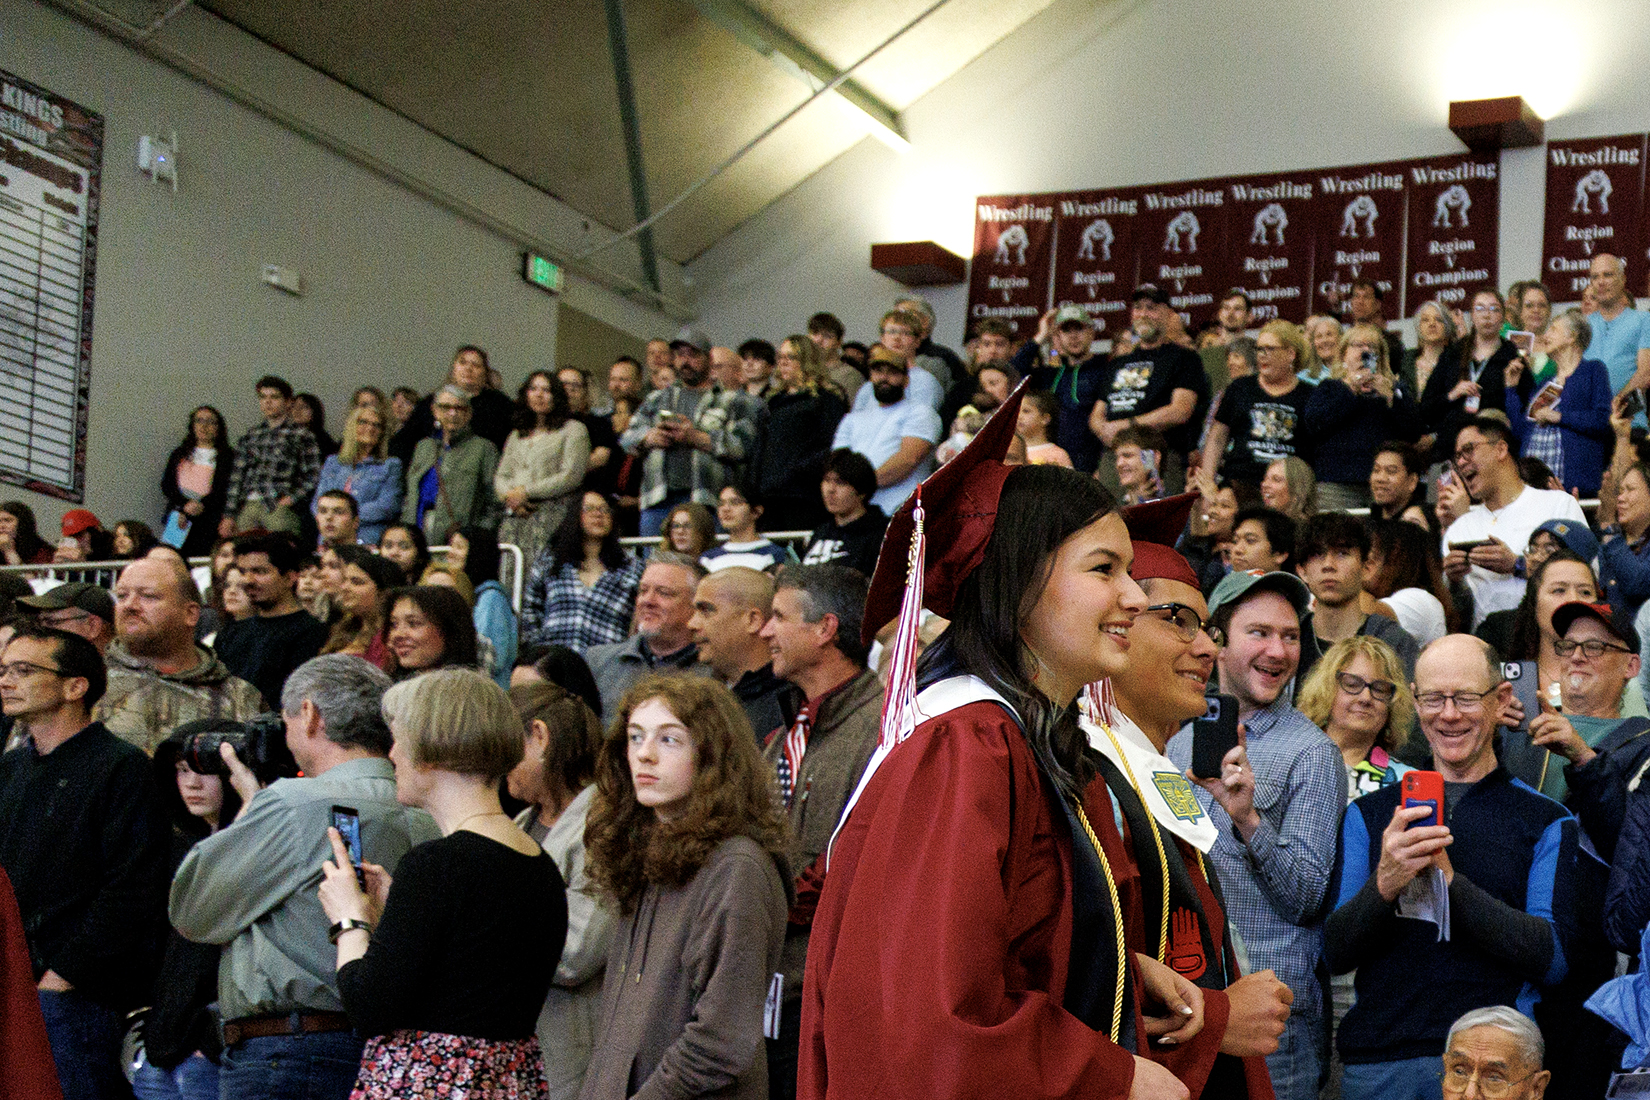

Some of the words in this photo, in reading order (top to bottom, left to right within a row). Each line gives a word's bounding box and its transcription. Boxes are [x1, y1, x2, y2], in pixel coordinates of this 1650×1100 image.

[1551, 146, 1640, 166] Wrestling
[1411, 162, 1498, 185] Wrestling
[1231, 181, 1313, 201] Wrestling
[1321, 172, 1404, 194] Wrestling
[1060, 197, 1138, 217] Wrestling
[1144, 189, 1224, 210] Wrestling
[977, 203, 1054, 223] Wrestling
[1566, 225, 1614, 242] Region
[1428, 238, 1476, 255] Region
[1584, 241, 1595, 255] V
[1244, 256, 1289, 272] Region
[1335, 249, 1380, 266] Region
[1446, 254, 1458, 268] V
[1073, 271, 1116, 286] Region
[1159, 263, 1202, 279] Region
[1259, 271, 1272, 285] V
[1351, 265, 1363, 279] V
[1414, 267, 1489, 286] Champions
[988, 275, 1029, 291] Region
[1174, 279, 1186, 293] V
[1088, 285, 1099, 299] V
